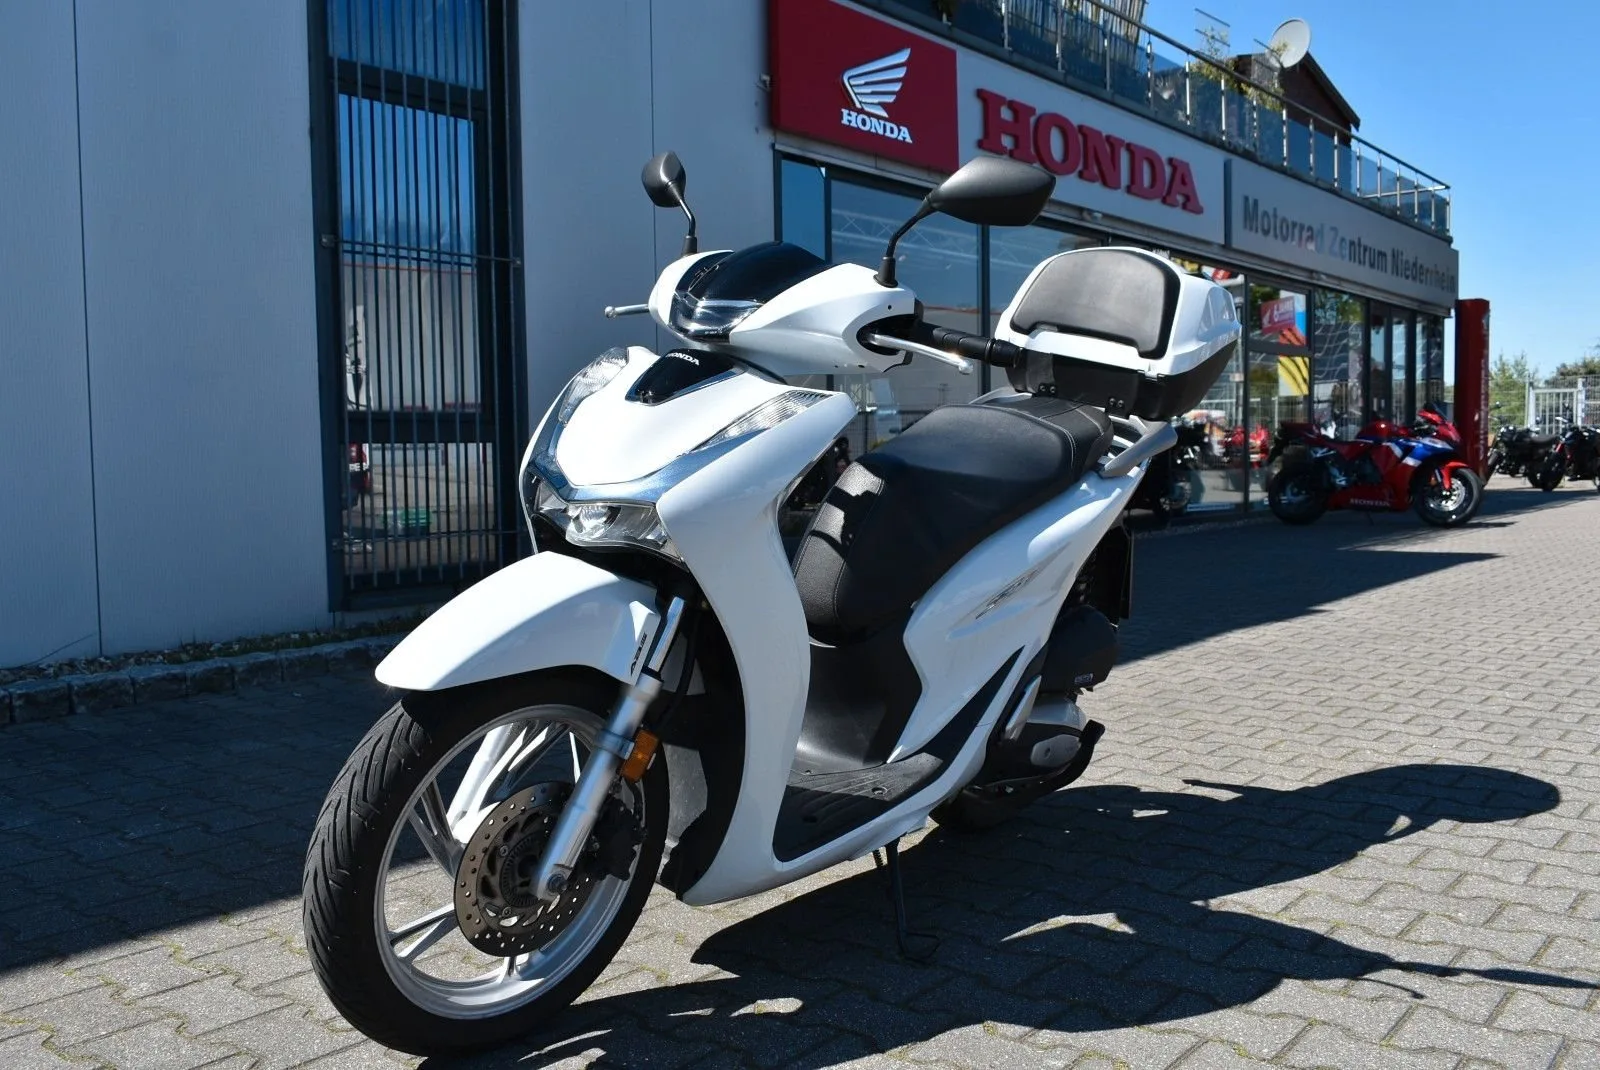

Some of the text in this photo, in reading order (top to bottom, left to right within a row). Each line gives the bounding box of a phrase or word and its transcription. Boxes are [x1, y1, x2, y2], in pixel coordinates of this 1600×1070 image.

[841, 107, 913, 144] HONDA
[976, 87, 1204, 215] HONDA
[1242, 195, 1456, 294] Motorrad Zentrum Niederrhein
